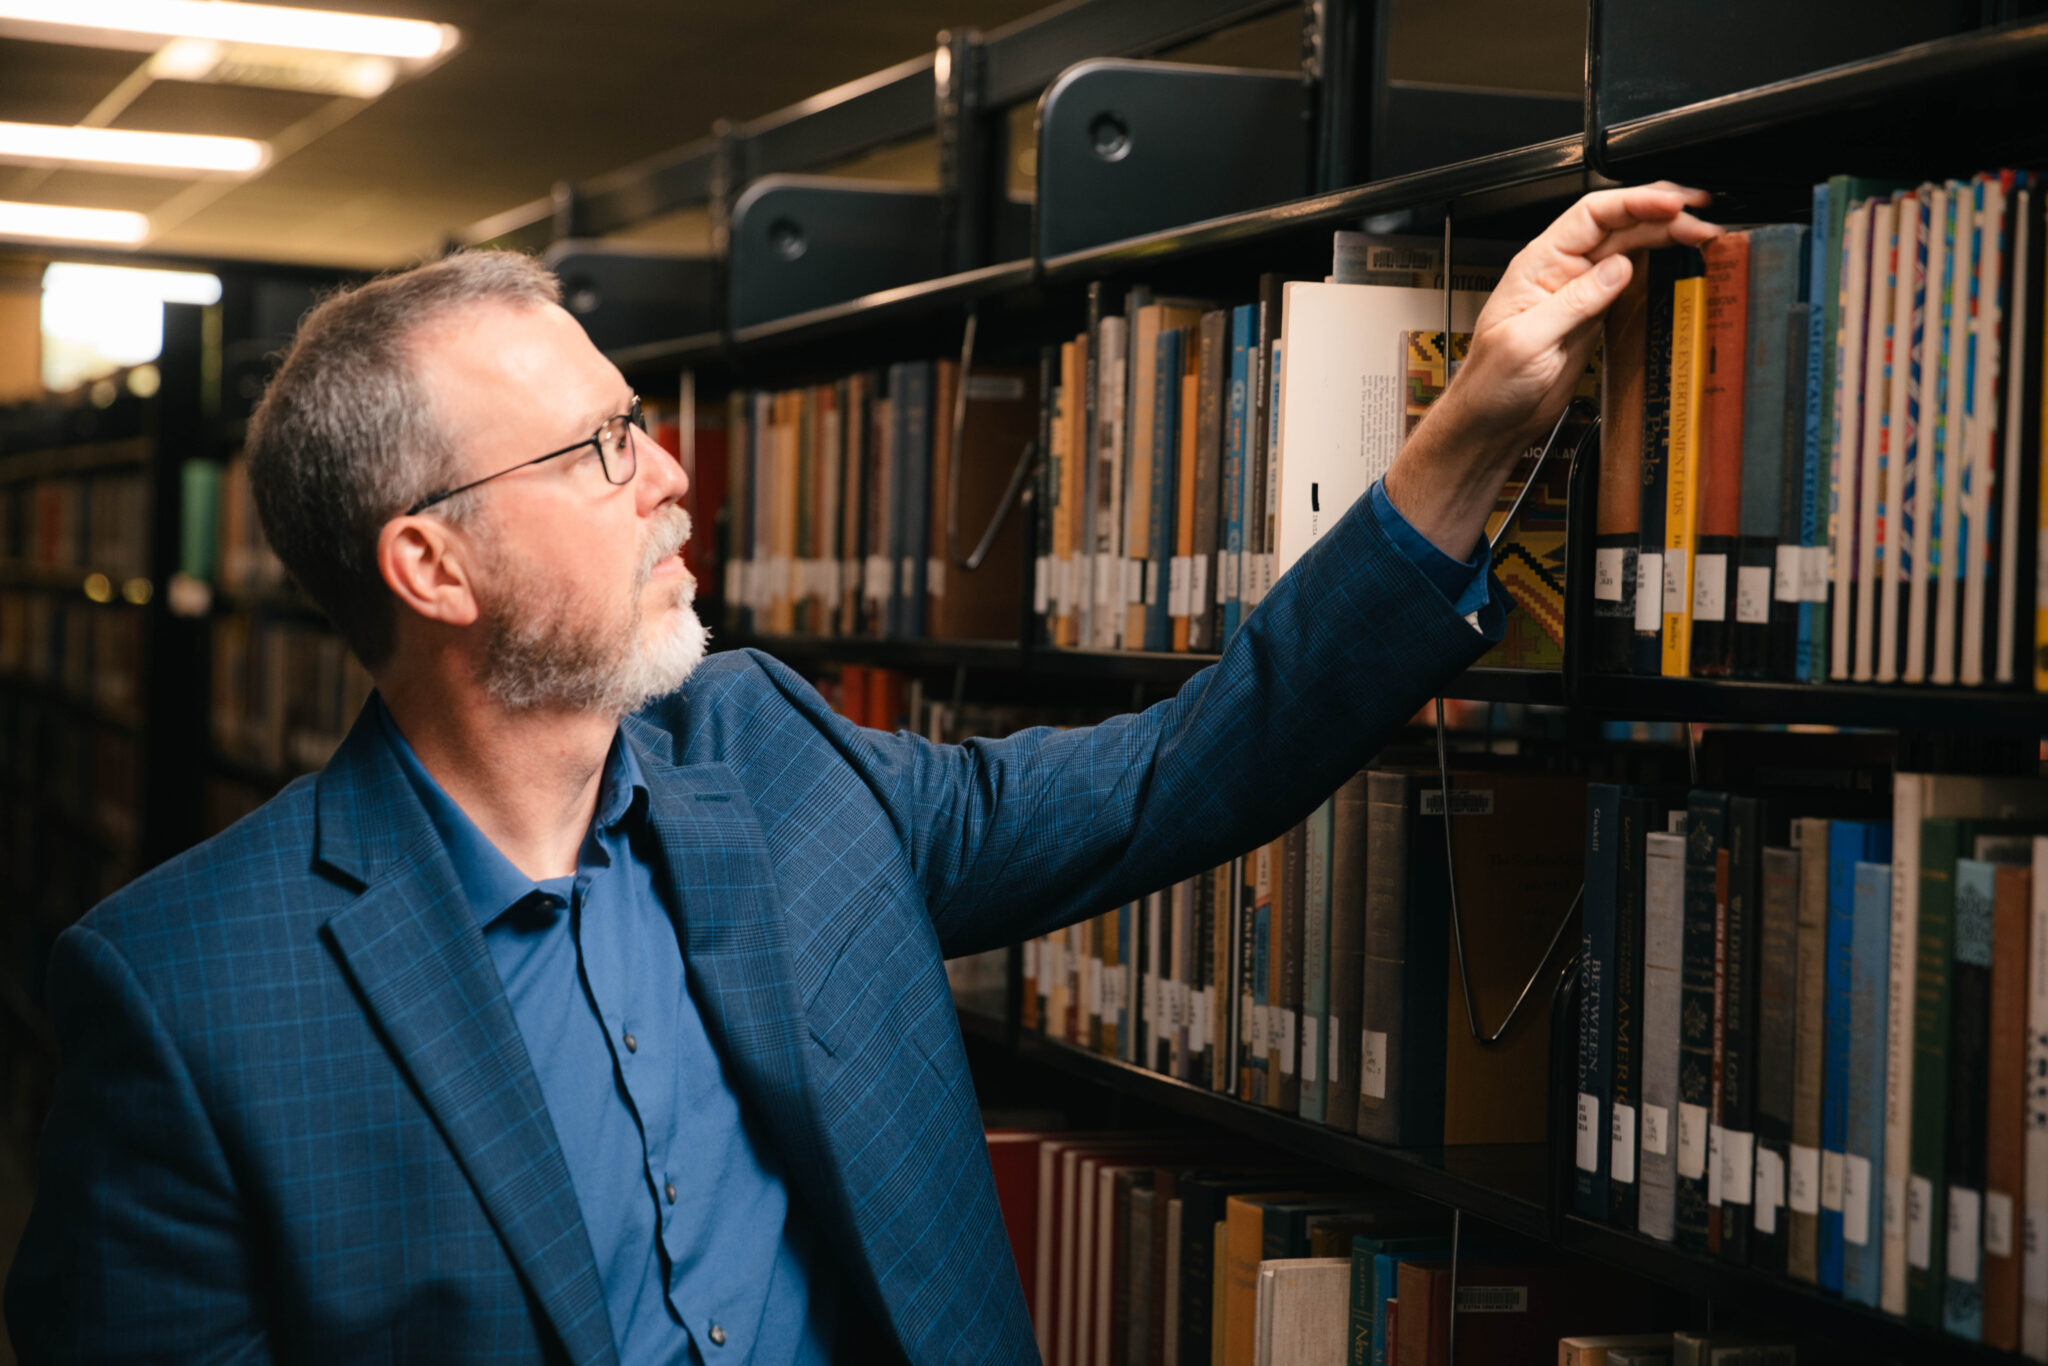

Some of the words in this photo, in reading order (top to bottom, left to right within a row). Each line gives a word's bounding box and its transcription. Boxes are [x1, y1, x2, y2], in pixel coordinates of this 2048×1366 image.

[1678, 335, 1690, 346] &
[1679, 296, 1692, 332] ARTS
[1806, 303, 1825, 416] AMERICAN
[1673, 350, 1690, 476] ENTERTAINMENT
[1643, 413, 1662, 486] Parks
[1672, 480, 1684, 516] FADS
[1800, 427, 1819, 546] YESTERDAY
[1312, 853, 1324, 897] TONY
[1893, 861, 1907, 924] AFTER
[1310, 902, 1322, 981] HORWITZ
[1714, 903, 1726, 941] GOLDEN
[1714, 942, 1725, 960] AGE
[1891, 930, 1905, 971] THE
[1581, 933, 1593, 989] TWO
[1714, 962, 1724, 975] OF
[1727, 895, 1743, 1031] WILDERNESS
[1588, 959, 1602, 1073] BETWEEN
[1713, 976, 1724, 1019] COLONIAL
[1577, 991, 1592, 1094] WORLDS
[1613, 996, 1632, 1105] AMERIC
[1712, 1022, 1723, 1063] CULTURE
[1886, 981, 1902, 1128] REVOLUTION
[1725, 1048, 1740, 1107] LOST
